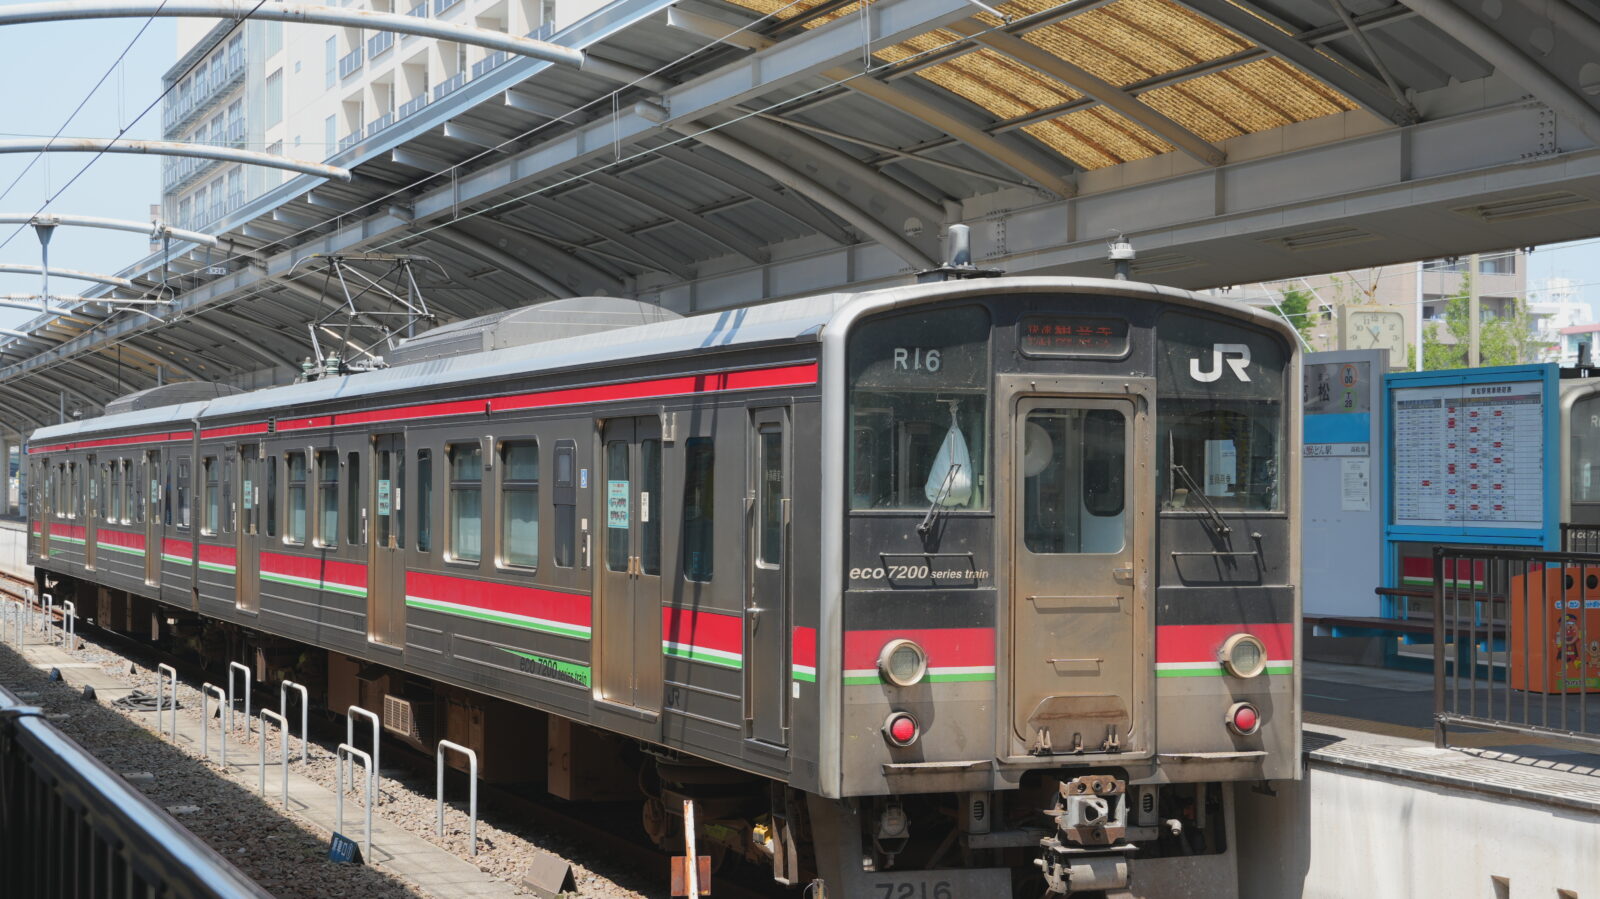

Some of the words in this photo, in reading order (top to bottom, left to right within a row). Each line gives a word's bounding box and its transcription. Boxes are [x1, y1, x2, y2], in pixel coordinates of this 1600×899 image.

[894, 347, 940, 372] R16
[1190, 343, 1252, 383] JR
[1346, 367, 1351, 375] Y
[849, 567, 885, 579] eco
[888, 565, 929, 579] 7200
[930, 569, 962, 579] series
[965, 569, 989, 579] train
[520, 657, 536, 674] eco
[538, 658, 558, 679] 7200
[875, 881, 952, 899] 7216
